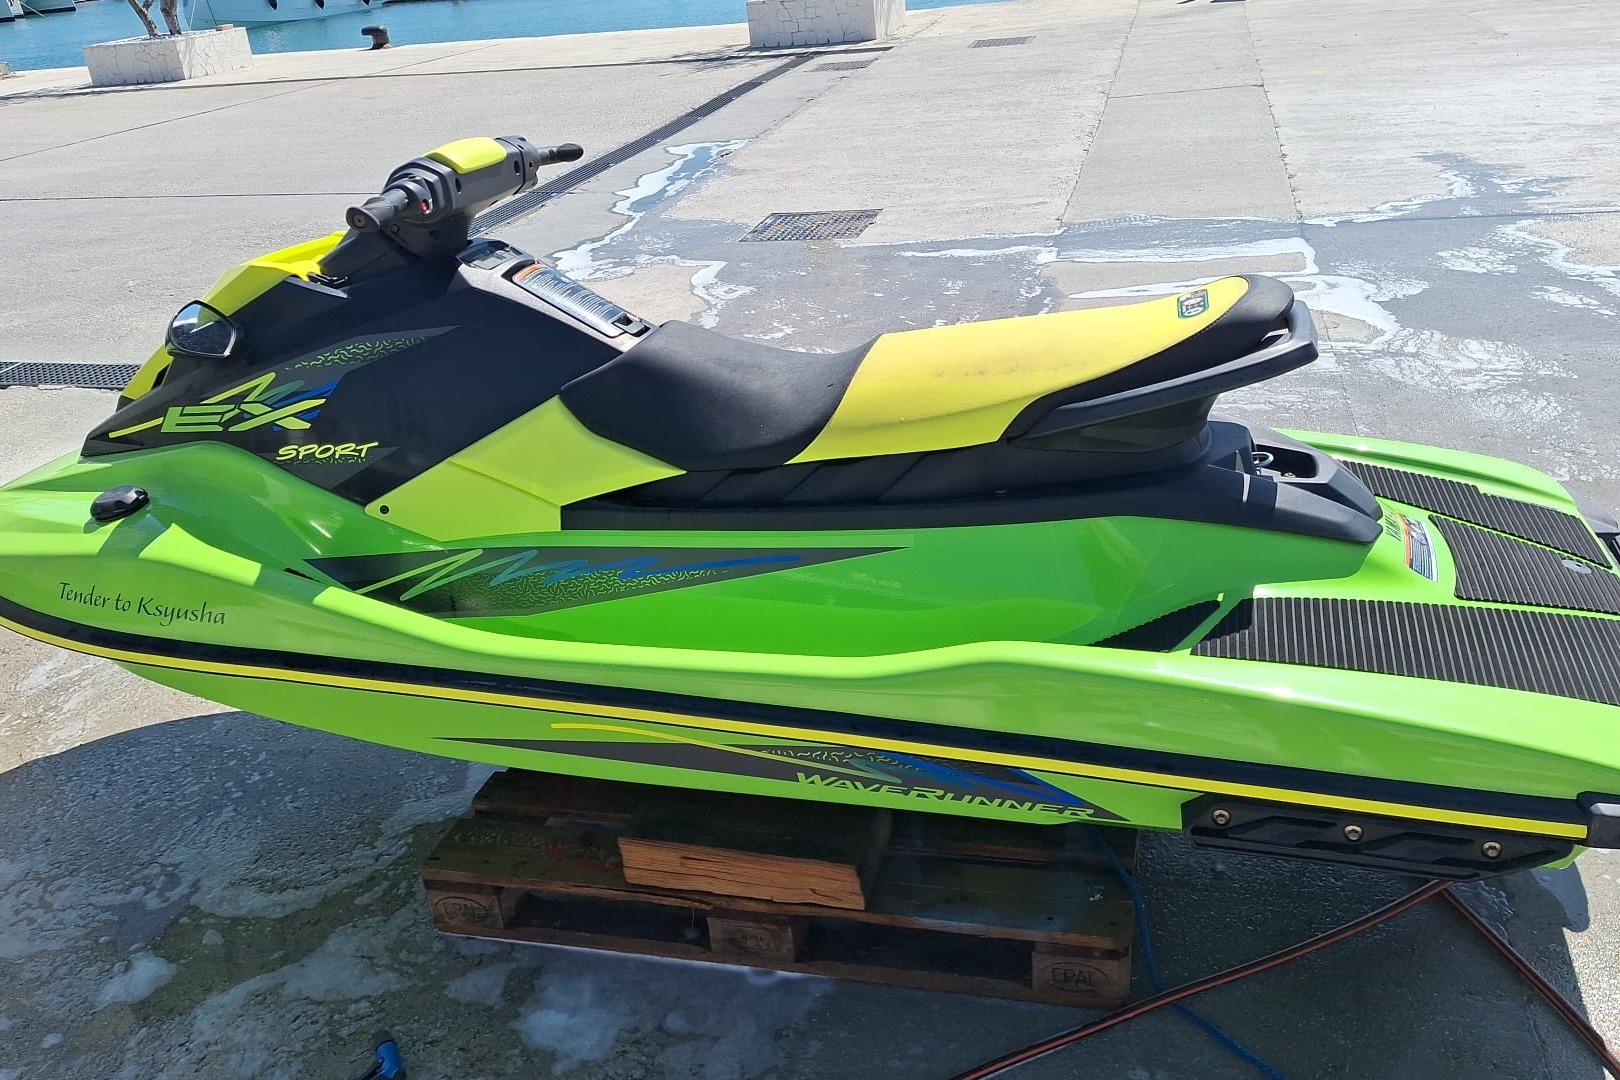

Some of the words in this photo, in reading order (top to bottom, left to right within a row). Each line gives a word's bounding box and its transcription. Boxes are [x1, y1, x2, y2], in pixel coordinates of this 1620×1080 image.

[160, 398, 326, 433] EX
[275, 441, 379, 462] SPORT
[59, 582, 111, 608] Tender
[114, 592, 132, 612] to
[137, 596, 226, 627] Ksyusha
[796, 771, 1095, 819] WAVERUNNER
